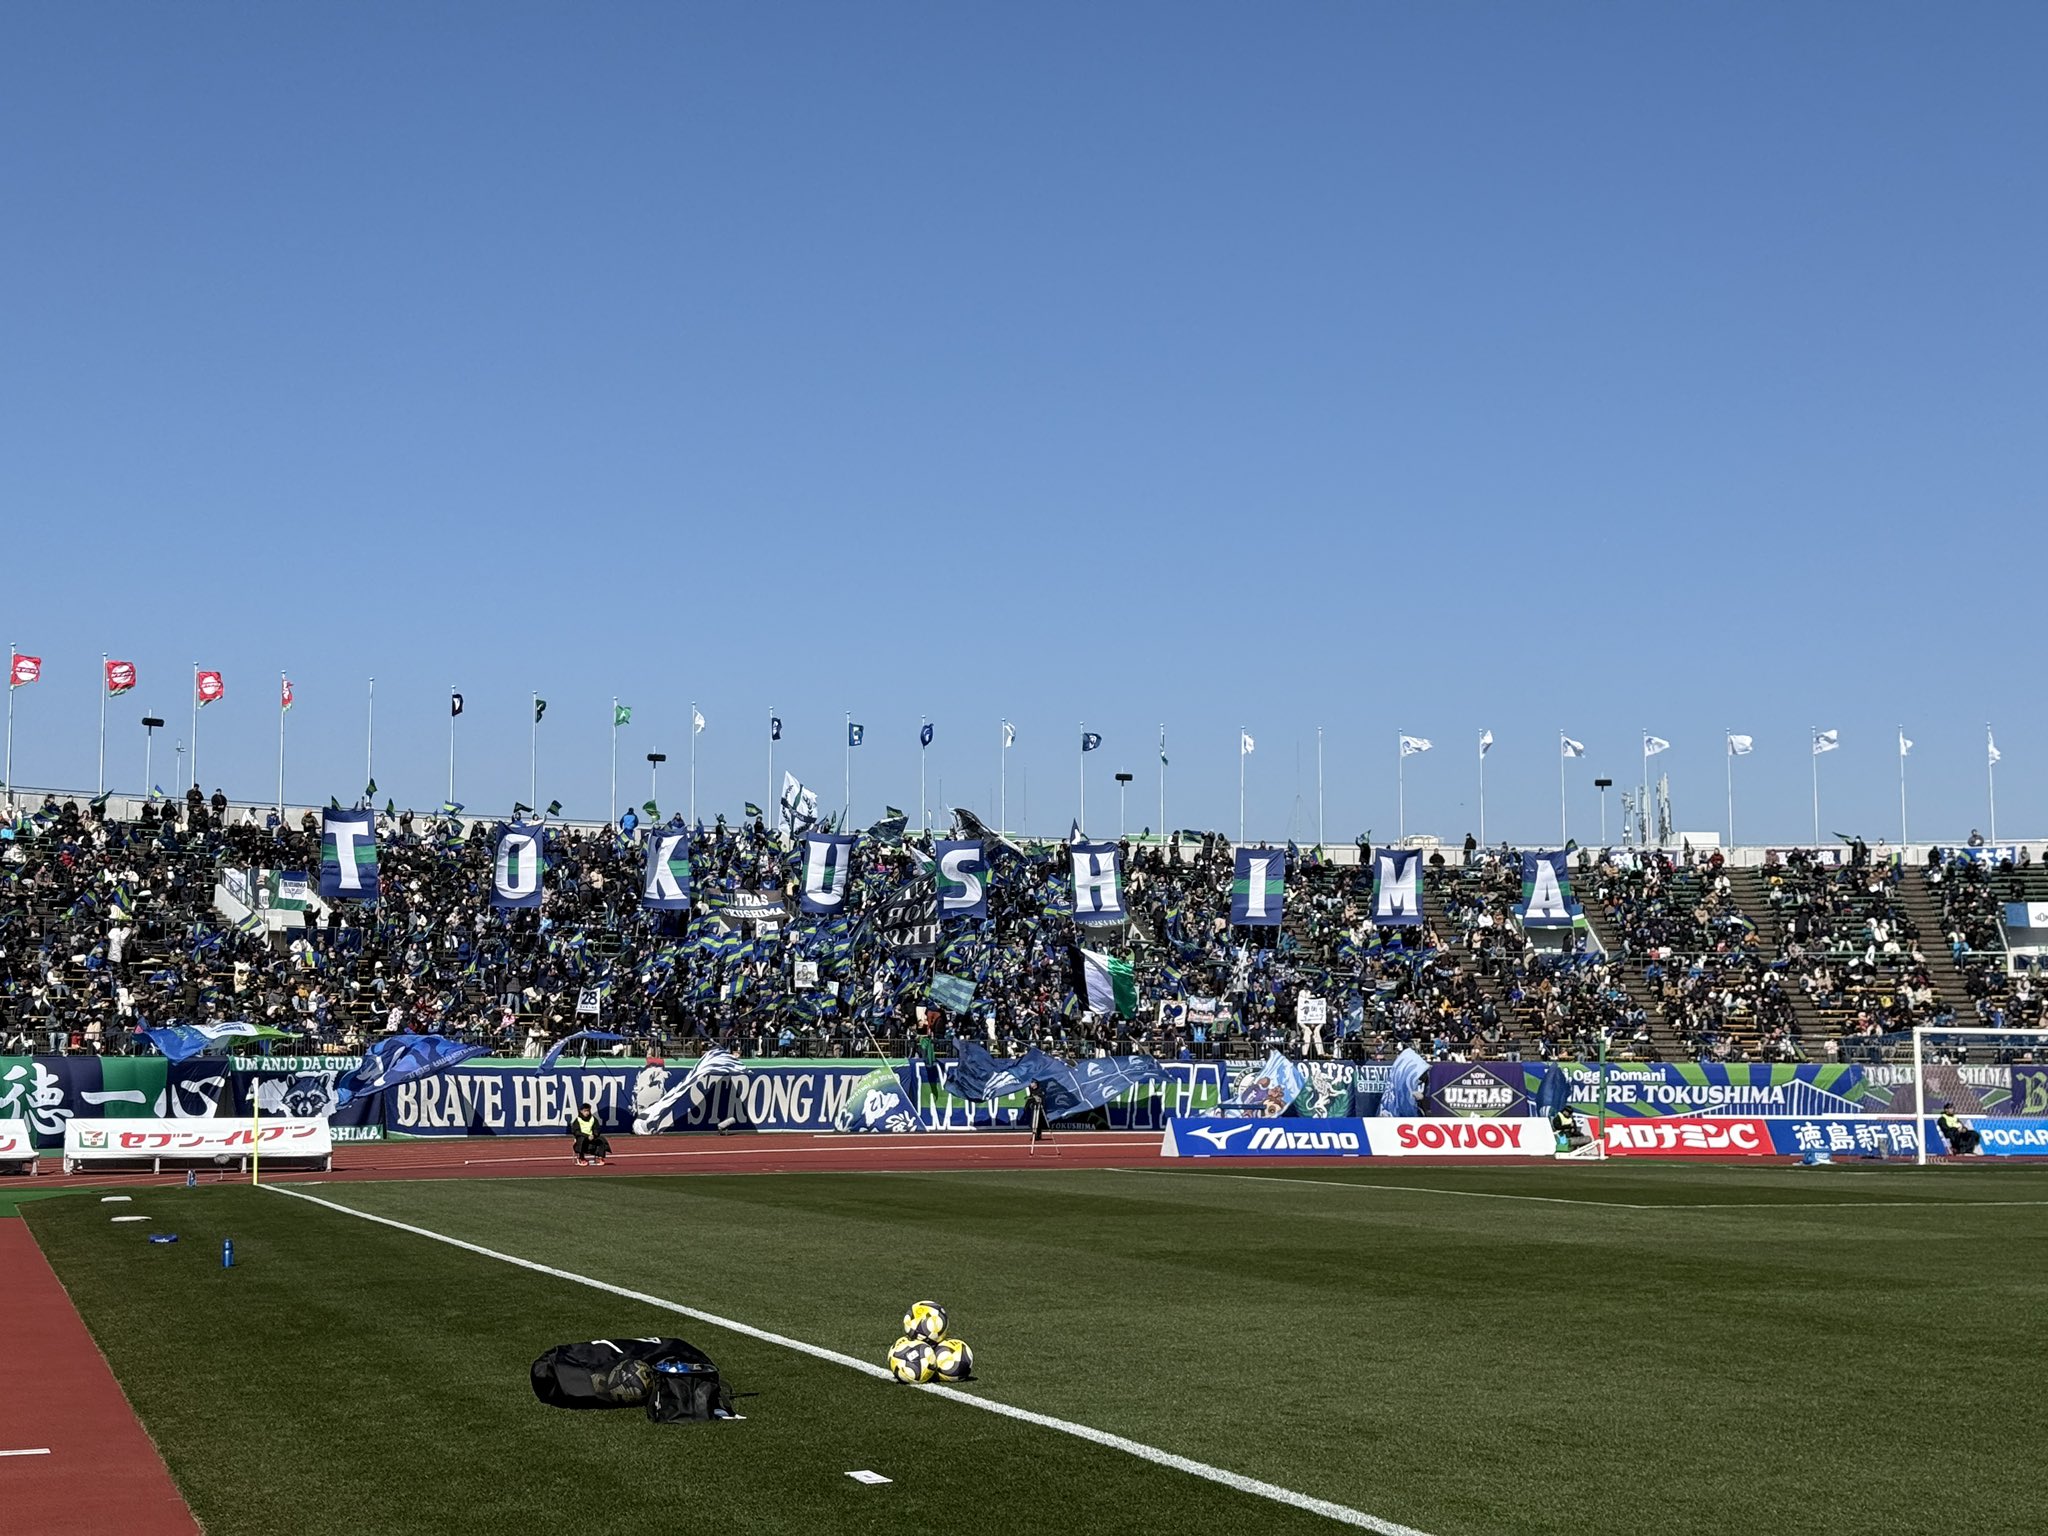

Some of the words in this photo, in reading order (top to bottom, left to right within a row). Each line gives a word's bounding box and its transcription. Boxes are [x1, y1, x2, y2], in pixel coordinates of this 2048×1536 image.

[325, 821, 368, 889] T
[505, 833, 538, 899] O
[646, 834, 687, 900] K
[806, 841, 852, 905] U
[941, 848, 982, 909] S
[1072, 852, 1121, 912] H
[1248, 858, 1268, 917] I
[1377, 856, 1422, 916] M
[1526, 860, 1567, 918] A
[580, 991, 597, 1005] 28
[235, 1057, 257, 1070] UM
[262, 1057, 297, 1070] ANJO
[302, 1057, 321, 1069] DA
[1297, 1062, 1354, 1084] ORTIS
[1610, 1068, 1666, 1082] Domani
[397, 1074, 505, 1128] BRAVE
[513, 1074, 625, 1127] HEART
[688, 1074, 814, 1125] STRONG
[1445, 1088, 1513, 1104] ULTRAS
[1641, 1085, 1785, 1104] TOKUSHIMA
[329, 1126, 381, 1141] SHIMA
[1400, 1124, 1521, 1149] SOYJOY
[1604, 1123, 1760, 1149] オロナミンC
[1792, 1121, 1919, 1151] 徳島新聞
[1980, 1129, 2048, 1146] POCAR
